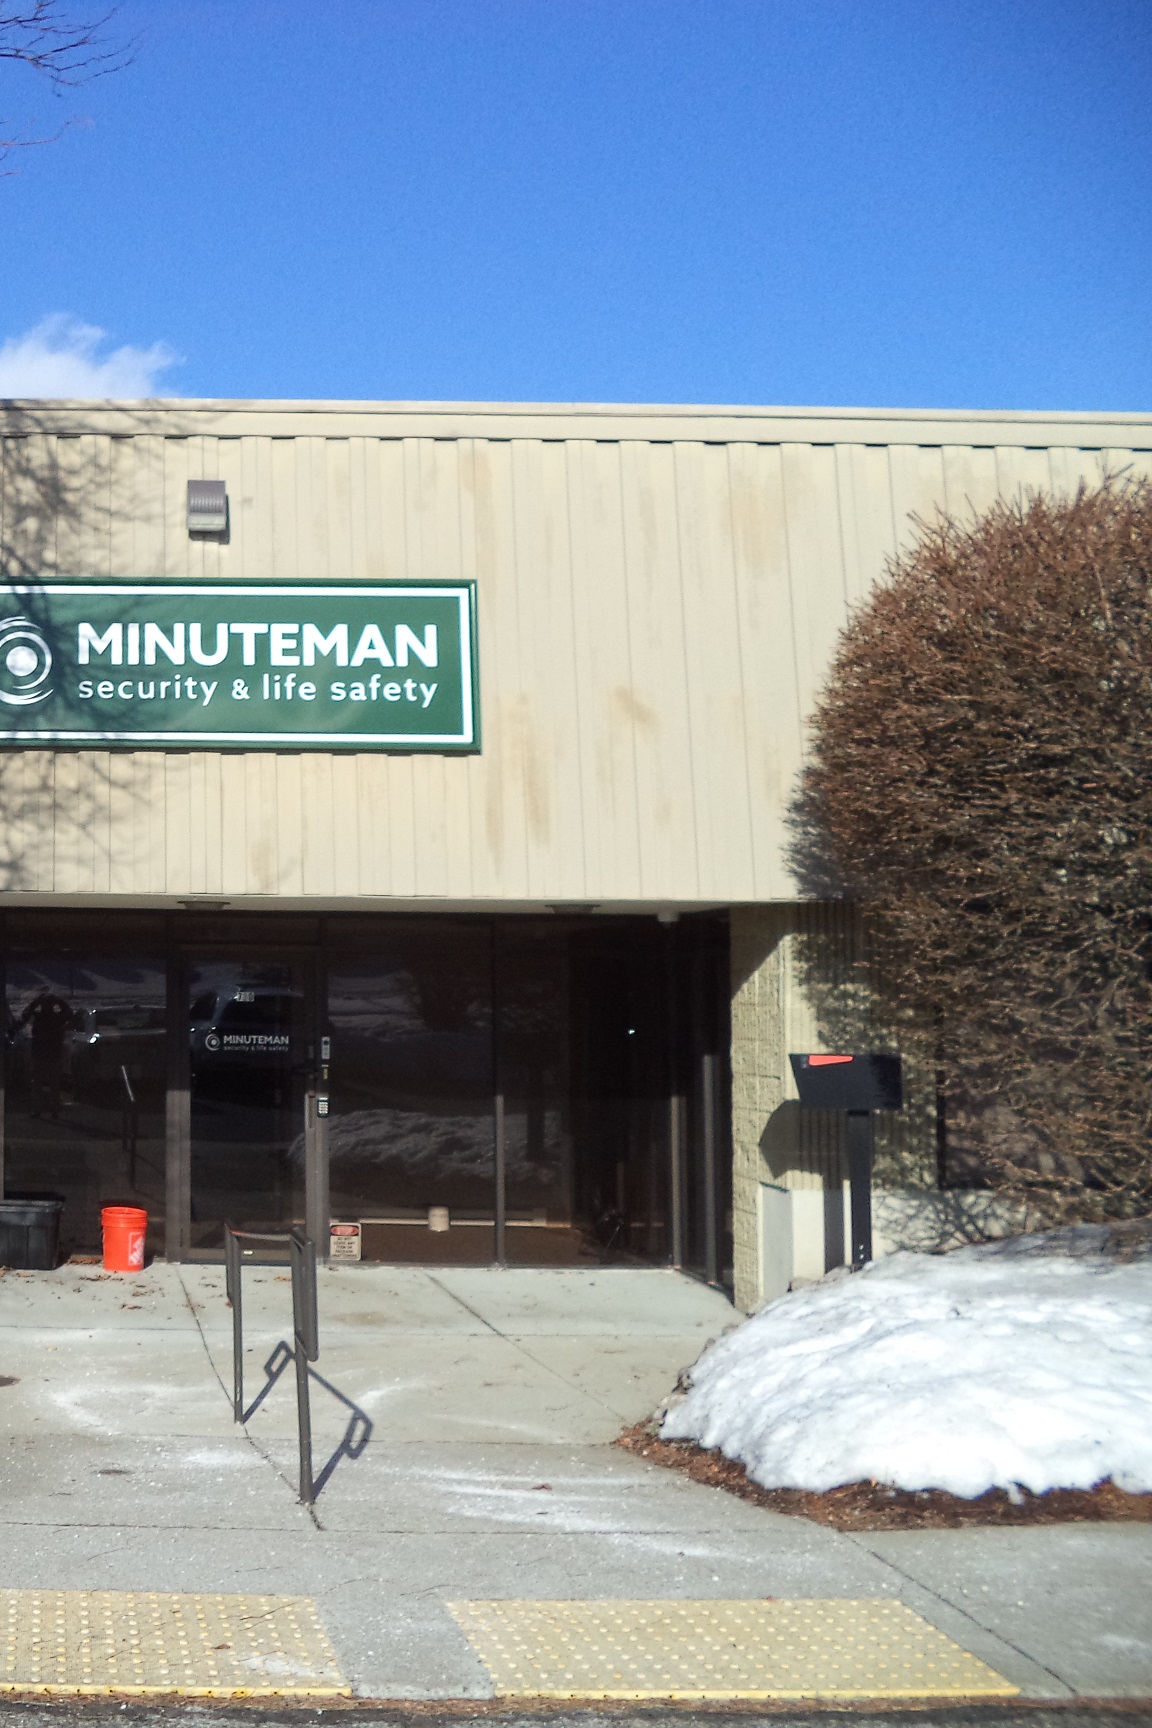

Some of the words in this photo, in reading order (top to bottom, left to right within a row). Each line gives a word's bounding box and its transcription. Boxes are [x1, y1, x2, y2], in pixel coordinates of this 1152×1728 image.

[77, 622, 438, 667] MINUTEMAN
[77, 673, 218, 707] security
[231, 678, 251, 700] &
[262, 672, 317, 701] life
[330, 673, 438, 709] safety
[223, 1035, 289, 1044] MINUTEMAN
